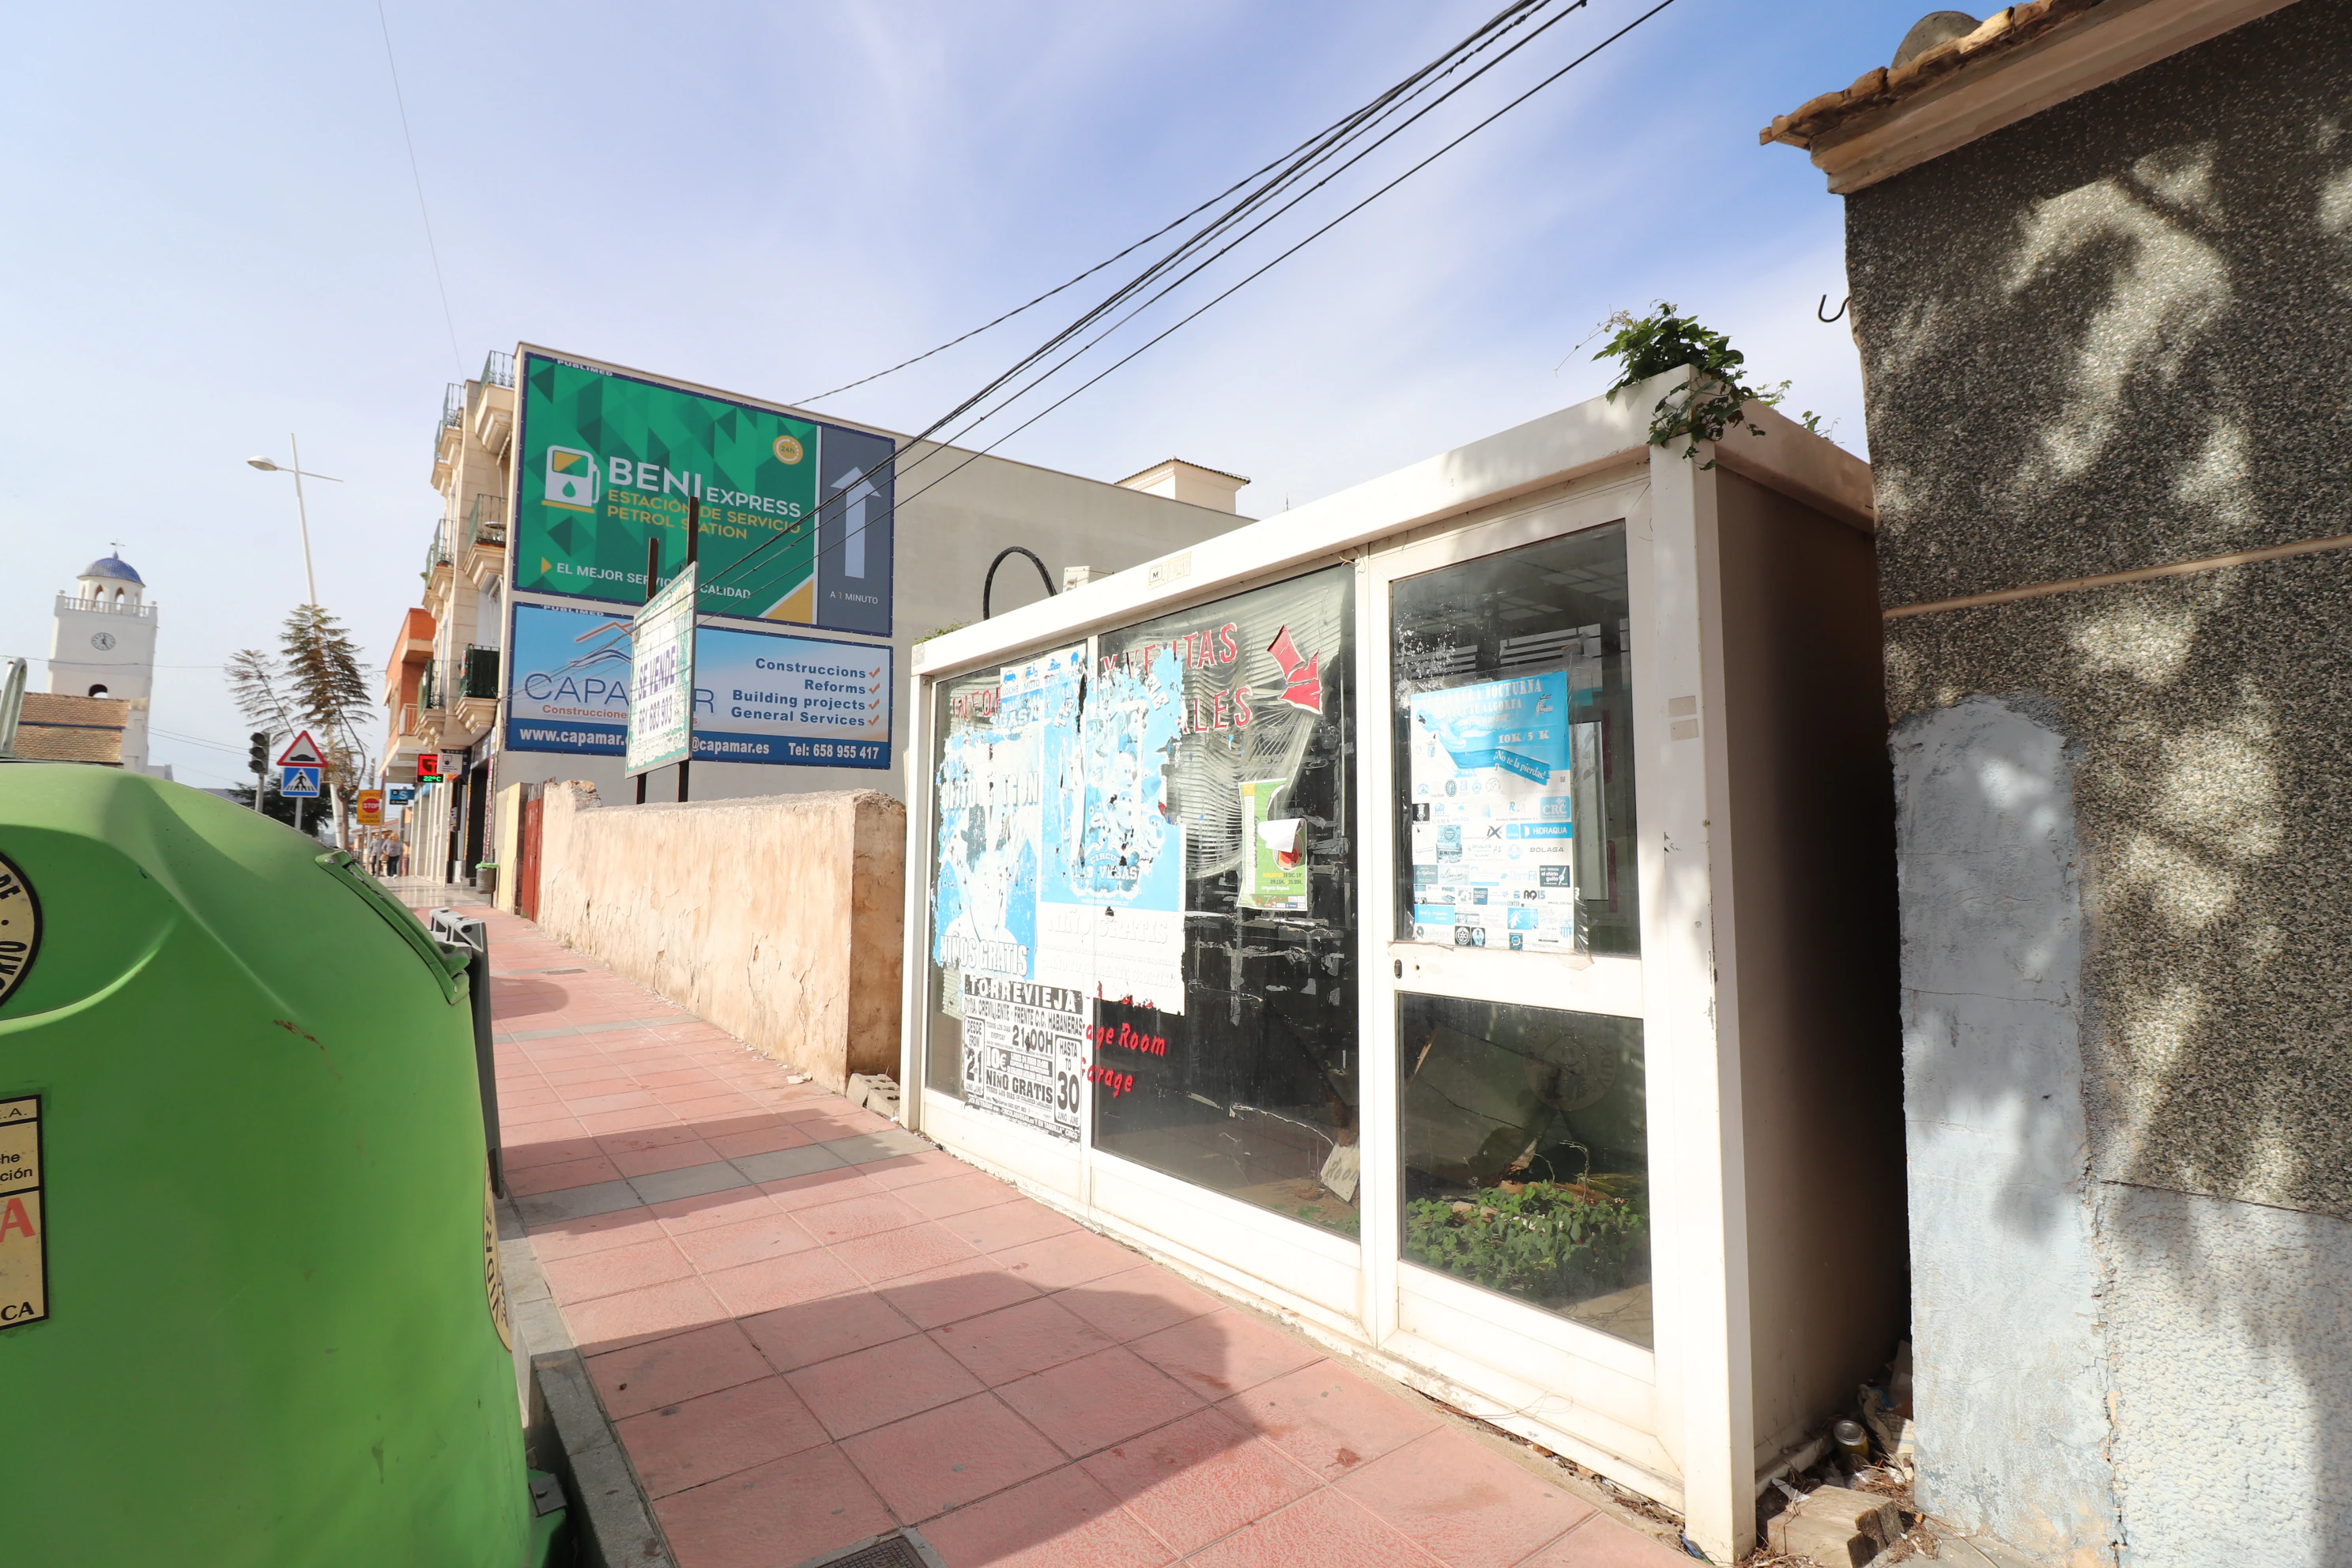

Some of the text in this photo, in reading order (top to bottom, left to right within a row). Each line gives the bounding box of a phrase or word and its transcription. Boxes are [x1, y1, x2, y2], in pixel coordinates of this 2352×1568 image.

[557, 359, 613, 377] PUBLIMED
[780, 445, 795, 454] 24h
[609, 456, 801, 518] BENI EXPRESS
[608, 489, 801, 534] ESTACIÓN DE SERVICIO
[608, 505, 748, 540] PETROL SATION
[556, 563, 573, 575] EL
[577, 566, 623, 582] MEJOR
[700, 583, 752, 599] CALIDAD
[845, 593, 878, 605] MINUTO
[543, 605, 605, 616] PUBLIMED
[639, 645, 677, 702] SE VENDE
[756, 658, 866, 678] Construccions
[805, 680, 866, 694] Reforms
[1023, 680, 1040, 690] MOTO
[1486, 678, 1542, 699] NOCTURNA
[733, 689, 865, 710] Building projects
[1483, 698, 1522, 713] ALGORFA
[731, 707, 865, 726] General Services
[519, 728, 628, 747] www.capamar.
[789, 742, 880, 760] Tel: 658 955 417
[1494, 750, 1547, 780] ¡No te la pierdas!
[1542, 805, 1567, 815] CRC
[1074, 865, 1139, 880] LAS VEGAS
[940, 931, 977, 969] NIÑOS
[979, 939, 1027, 977] GRATIS
[969, 975, 1076, 1012] TORREVIEJA
[967, 1020, 982, 1035] DESDE
[1014, 1006, 1034, 1026] FRENTE
[1048, 1012, 1083, 1036] HABANERAS
[969, 1035, 980, 1048] FROM
[1012, 1024, 1054, 1054] 2100H
[1059, 1039, 1078, 1058] HASTA
[1118, 1023, 1166, 1057] Room
[986, 1046, 1008, 1072] 10€
[1065, 1057, 1072, 1071] TO
[986, 1069, 1009, 1091] NIÑO
[1012, 1076, 1053, 1104] GRATIS
[986, 1085, 998, 1095] TODOS
[1057, 1071, 1080, 1114] 30
[1057, 1112, 1068, 1123] JUNIO
